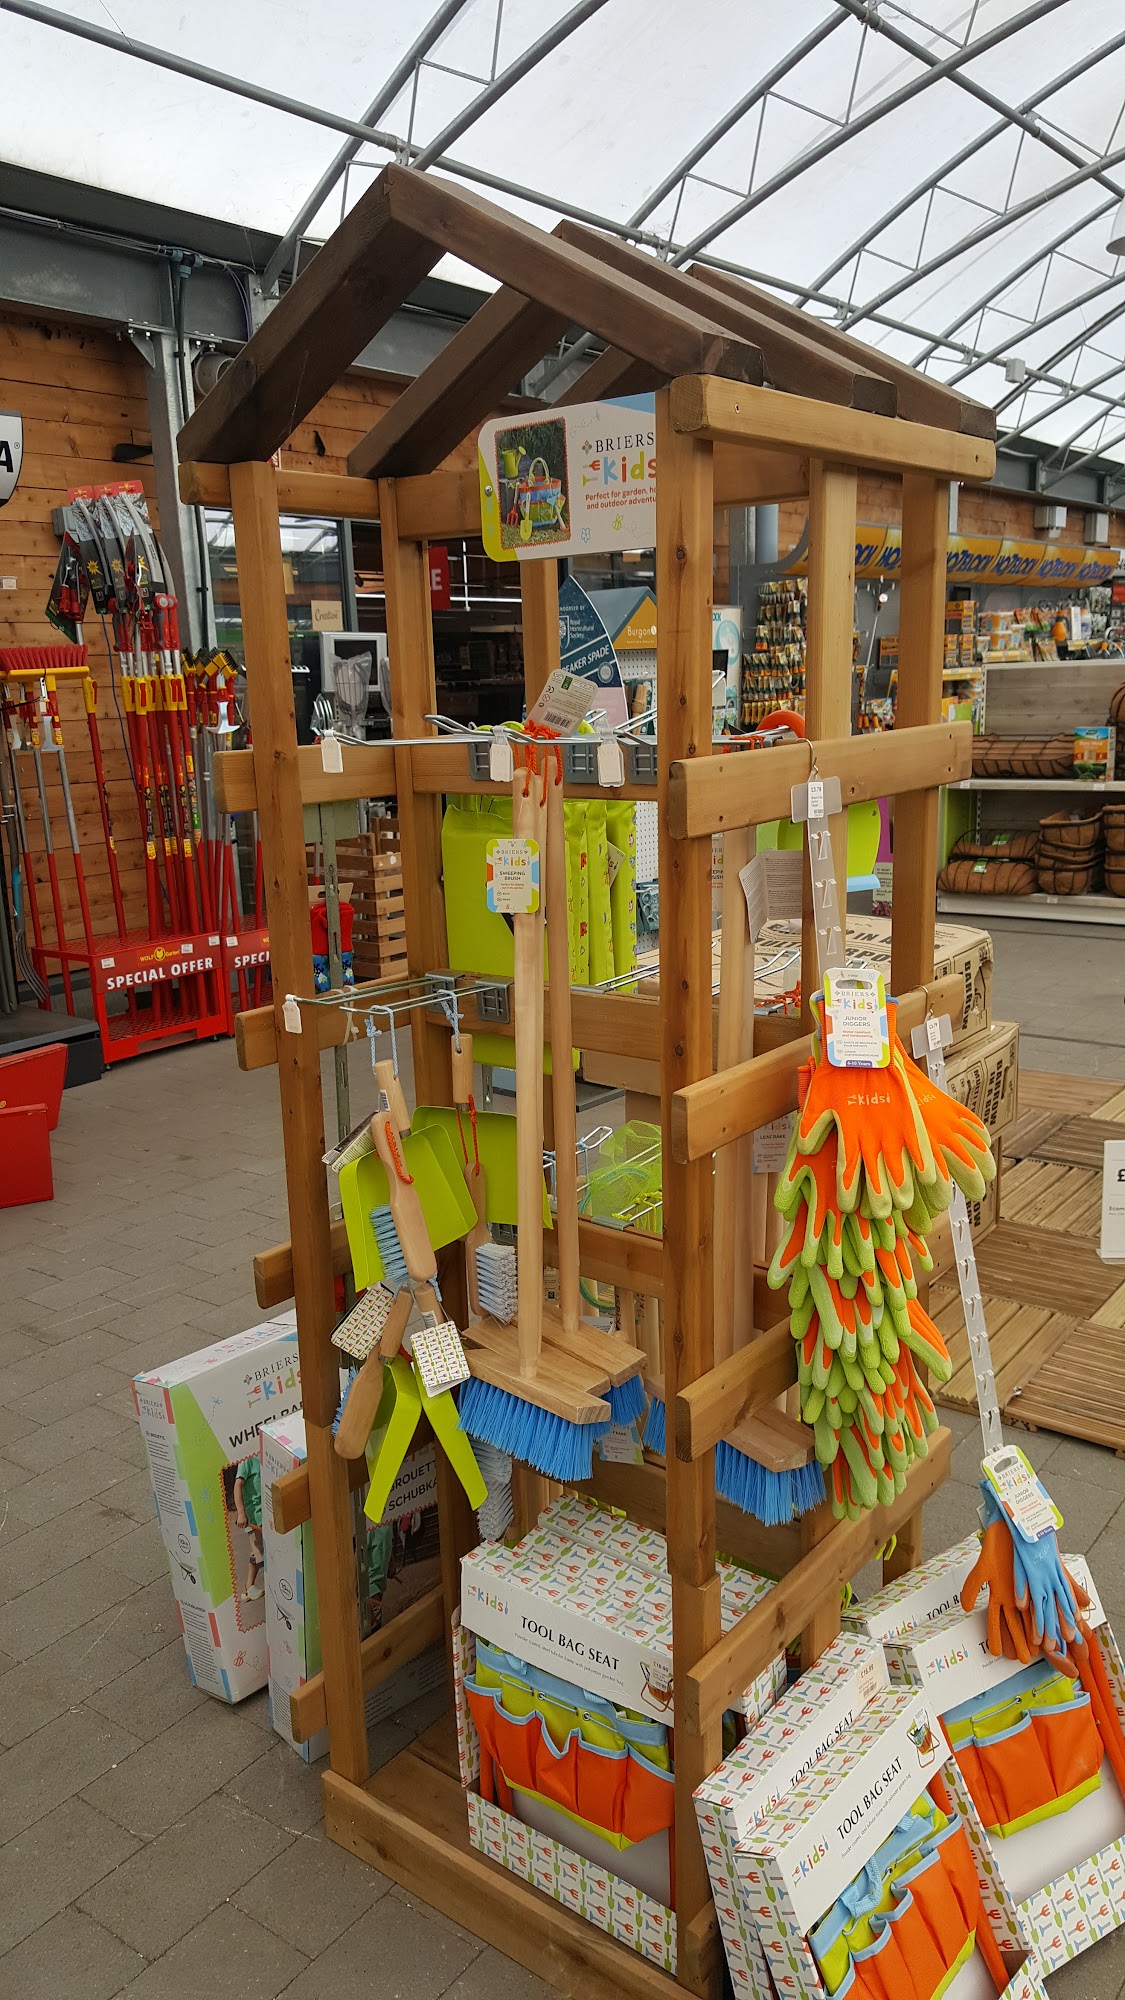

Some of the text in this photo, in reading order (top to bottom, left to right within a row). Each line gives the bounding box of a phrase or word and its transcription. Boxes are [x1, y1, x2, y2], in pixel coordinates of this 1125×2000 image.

[595, 432, 655, 453] BRIERS
[603, 450, 656, 485] kids
[585, 492, 610, 501] Perfect
[611, 490, 621, 498] for
[622, 487, 649, 499] garden,
[587, 502, 599, 510] and
[600, 500, 627, 508] outdoor
[991, 553, 1039, 576] HOZELOCK
[627, 626, 650, 638] Burgon
[587, 644, 610, 664] SPADE
[503, 855, 527, 867] kids
[106, 957, 213, 990] SPECIAL OFFER
[843, 998, 873, 1010] kids
[857, 1092, 885, 1106] kids
[989, 1059, 1003, 1126] BARROW
[254, 1352, 299, 1381] BRIERS
[1006, 1473, 1028, 1490] kids
[477, 1587, 504, 1612] kids
[888, 1620, 914, 1640] kids
[521, 1615, 620, 1671] TOOL BAG SEAT
[935, 1649, 964, 1673] kids
[789, 1709, 855, 1787] TOOL BAG SEAT
[752, 1794, 777, 1824] kids
[836, 1755, 903, 1840] TOOL BAG SEAT
[799, 1843, 827, 1878] kids
